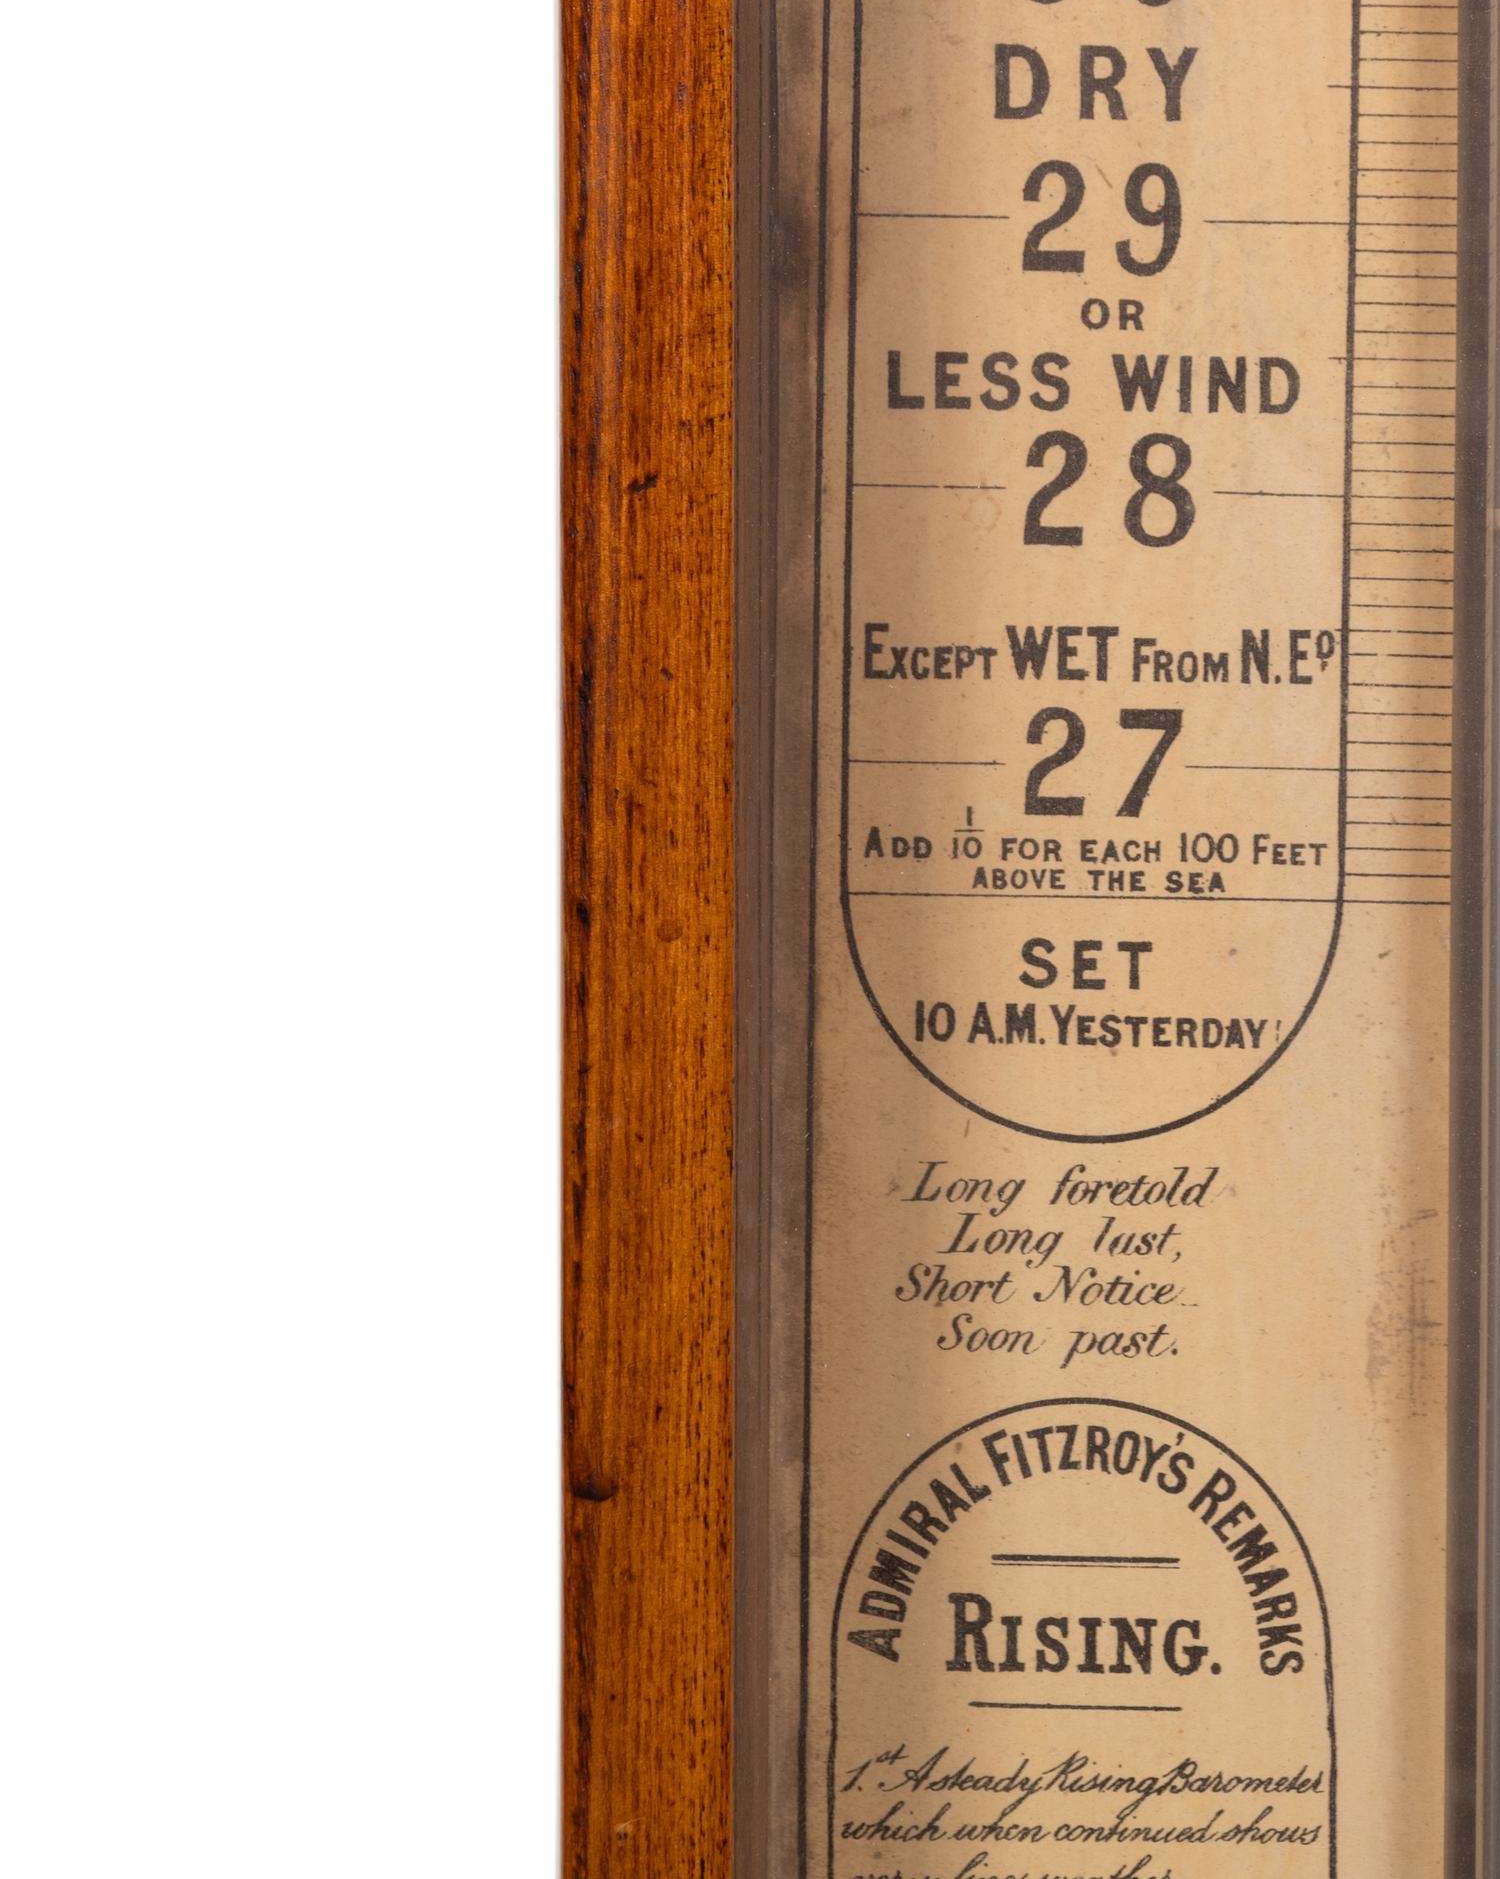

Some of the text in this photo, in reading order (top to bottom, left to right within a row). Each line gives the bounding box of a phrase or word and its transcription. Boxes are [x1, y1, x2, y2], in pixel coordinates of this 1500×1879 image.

[994, 42, 1198, 121] DRY
[1021, 160, 1182, 277] 29
[1080, 298, 1145, 331] OR
[888, 350, 1300, 414] LESS WIND
[1023, 429, 1196, 548] 28
[1005, 625, 1119, 682] WET
[1024, 707, 1183, 817] 27
[1001, 837, 1062, 862] FOR
[1080, 839, 1161, 864] EACH
[1179, 832, 1239, 864] 100
[972, 867, 1226, 894] ABOVE THE SEA
[1019, 938, 1153, 990] SET
[967, 1003, 1046, 1045] A.M.
[901, 1160, 1220, 1215] Long foretold
[936, 1212, 1183, 1268] Long last,
[895, 1262, 1018, 1304] Short
[937, 1312, 1179, 1368] Soon past.
[848, 1425, 1305, 1677] ADMIRAL FITZROY'S REMARKS
[956, 1757, 1044, 1820] steady
[1043, 1750, 1162, 1820] Rising
[1157, 1757, 1324, 1795] Barometer
[841, 1801, 1322, 1845] which when continued shows
